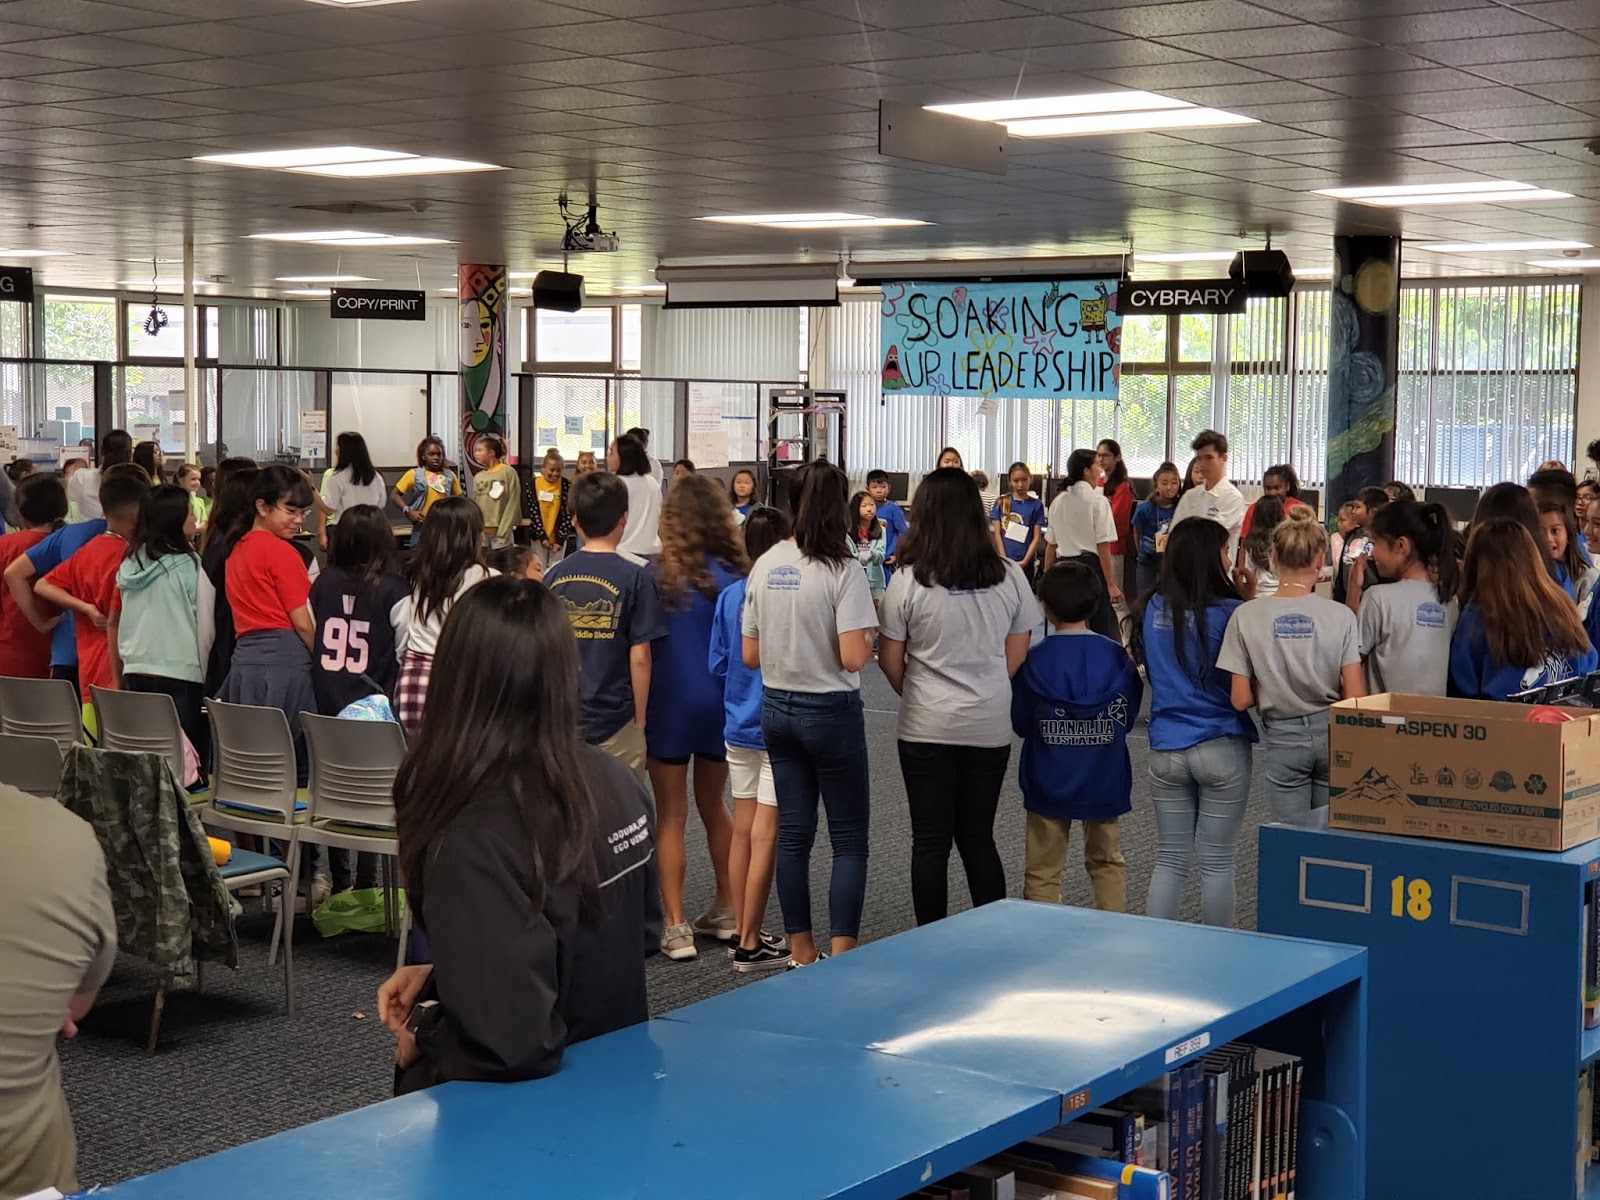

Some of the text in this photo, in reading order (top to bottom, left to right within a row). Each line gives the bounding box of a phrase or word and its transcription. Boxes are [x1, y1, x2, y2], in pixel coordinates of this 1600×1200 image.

[337, 297, 419, 310] COPY/PRINT
[1130, 288, 1235, 307] CYBRARY
[907, 292, 1079, 342] SOAKING
[904, 350, 1114, 393] UP LEADERSHIP
[321, 616, 370, 674] 95
[1395, 720, 1457, 739] ASPEN
[1463, 725, 1487, 741] 30
[1500, 803, 1520, 814] COPY
[1520, 805, 1545, 817] PAPER
[1391, 875, 1432, 921] 18
[1069, 1093, 1087, 1109] 165
